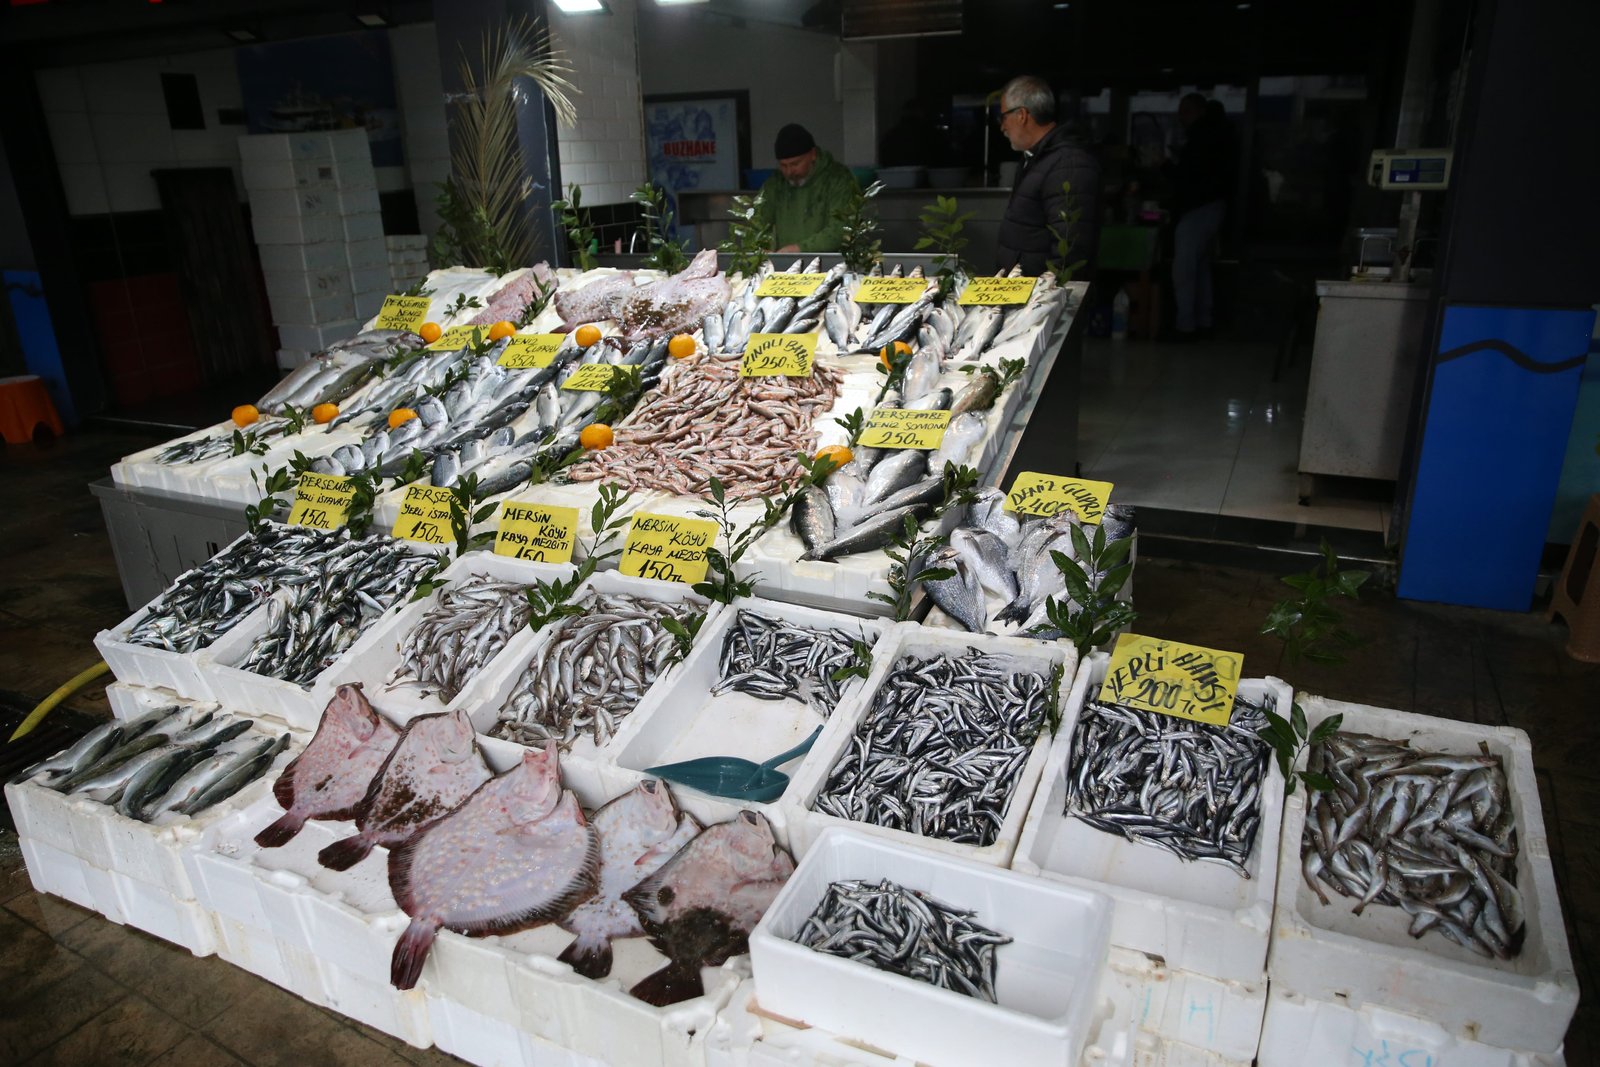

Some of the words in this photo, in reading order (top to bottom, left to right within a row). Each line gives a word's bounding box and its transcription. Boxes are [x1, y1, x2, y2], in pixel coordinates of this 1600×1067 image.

[663, 140, 716, 157] BUZHANE
[501, 531, 528, 545] KAYA
[669, 531, 707, 547] KÖYÜ
[628, 541, 663, 555] KAYA
